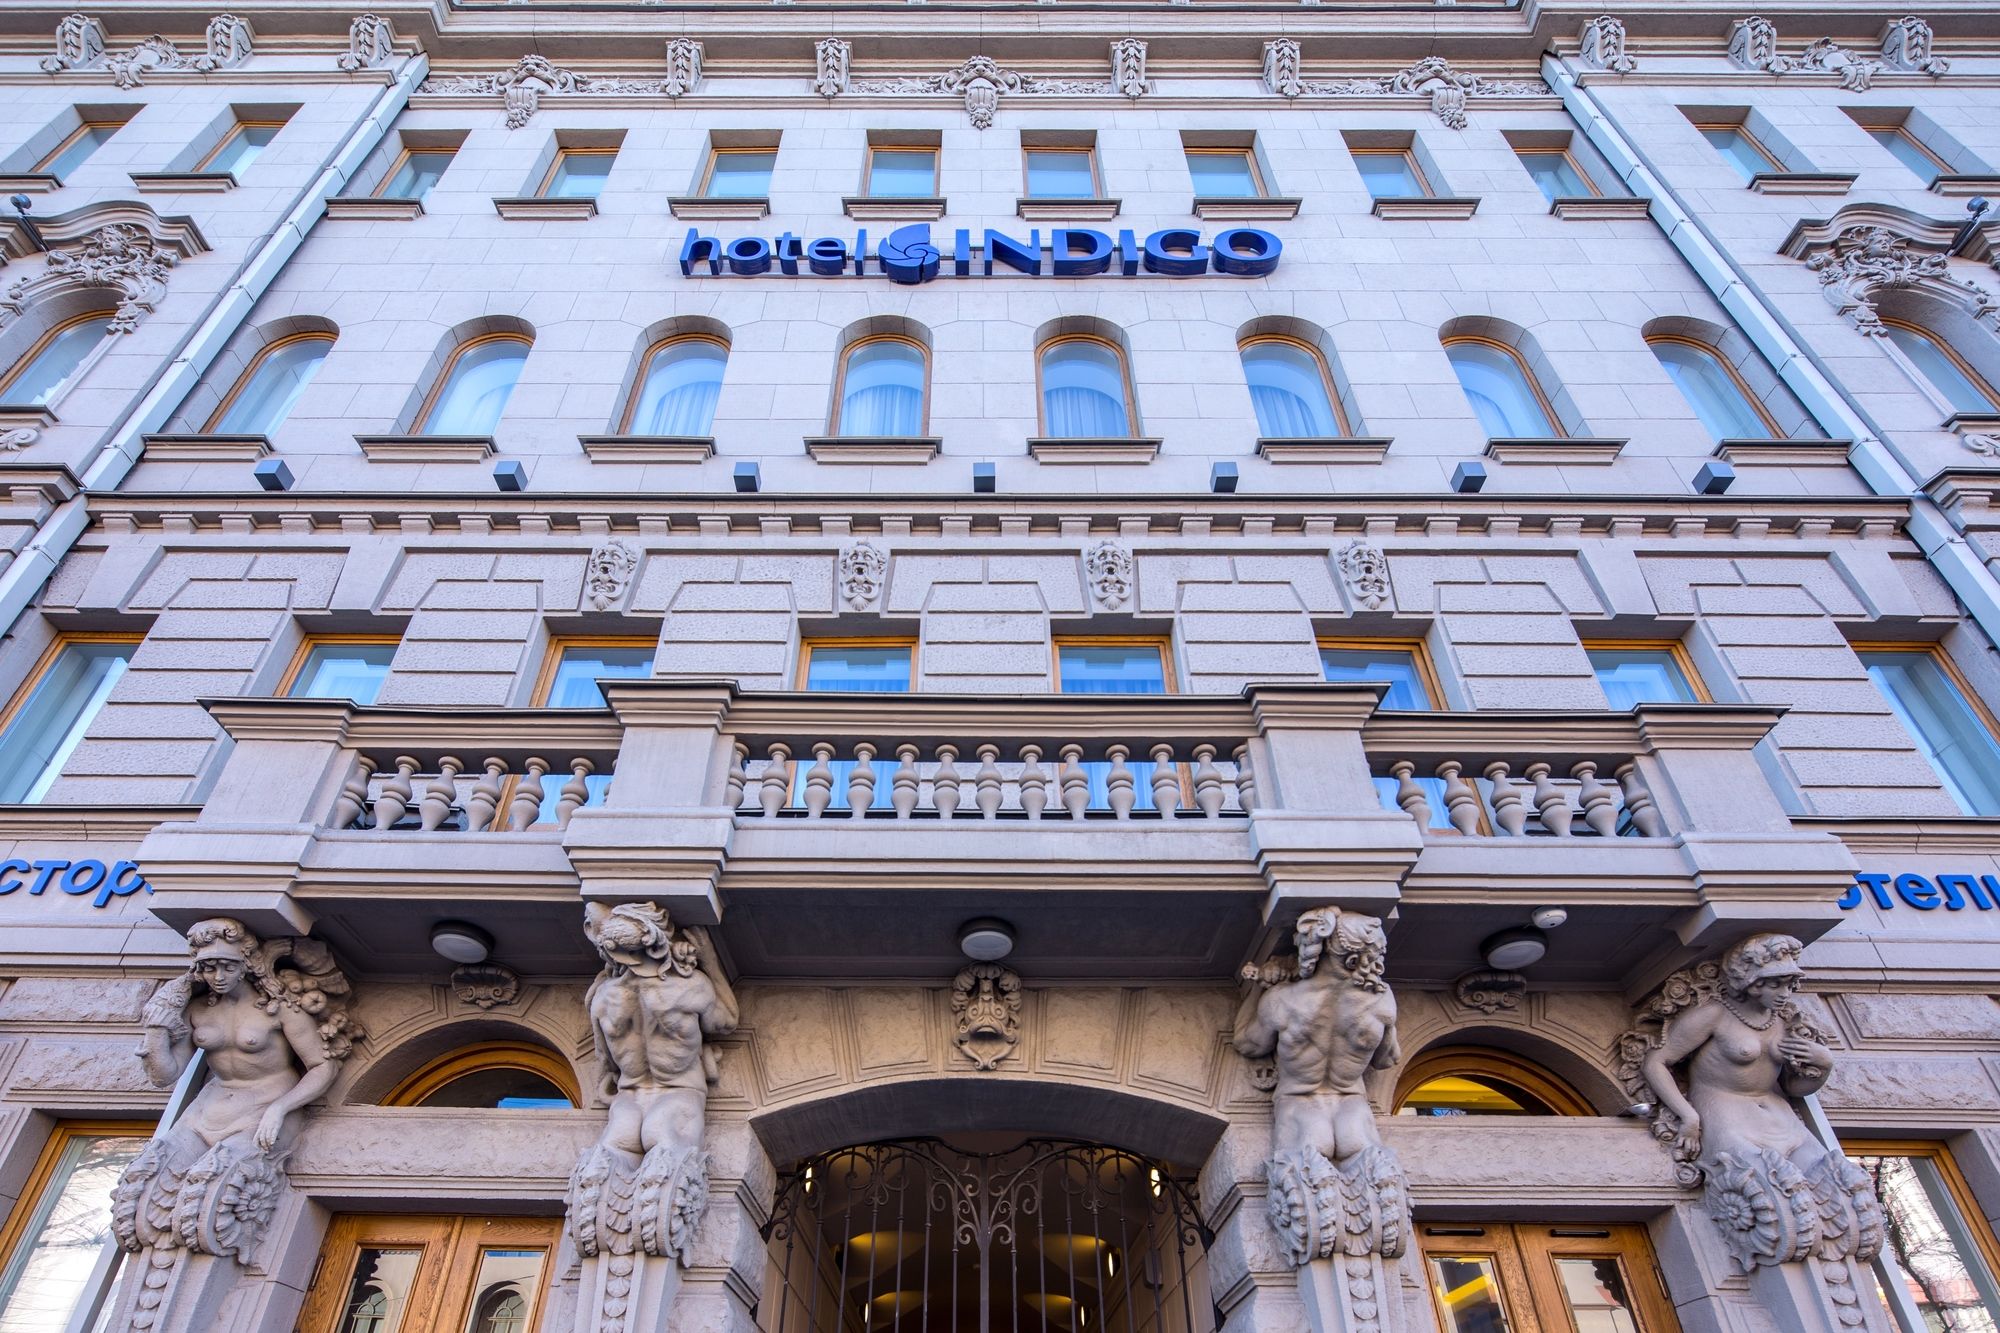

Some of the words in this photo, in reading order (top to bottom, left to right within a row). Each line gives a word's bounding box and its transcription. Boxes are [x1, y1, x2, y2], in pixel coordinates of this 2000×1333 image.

[680, 227, 867, 276] hotel
[954, 227, 1284, 276] INDIGO
[0, 858, 155, 908] стор
